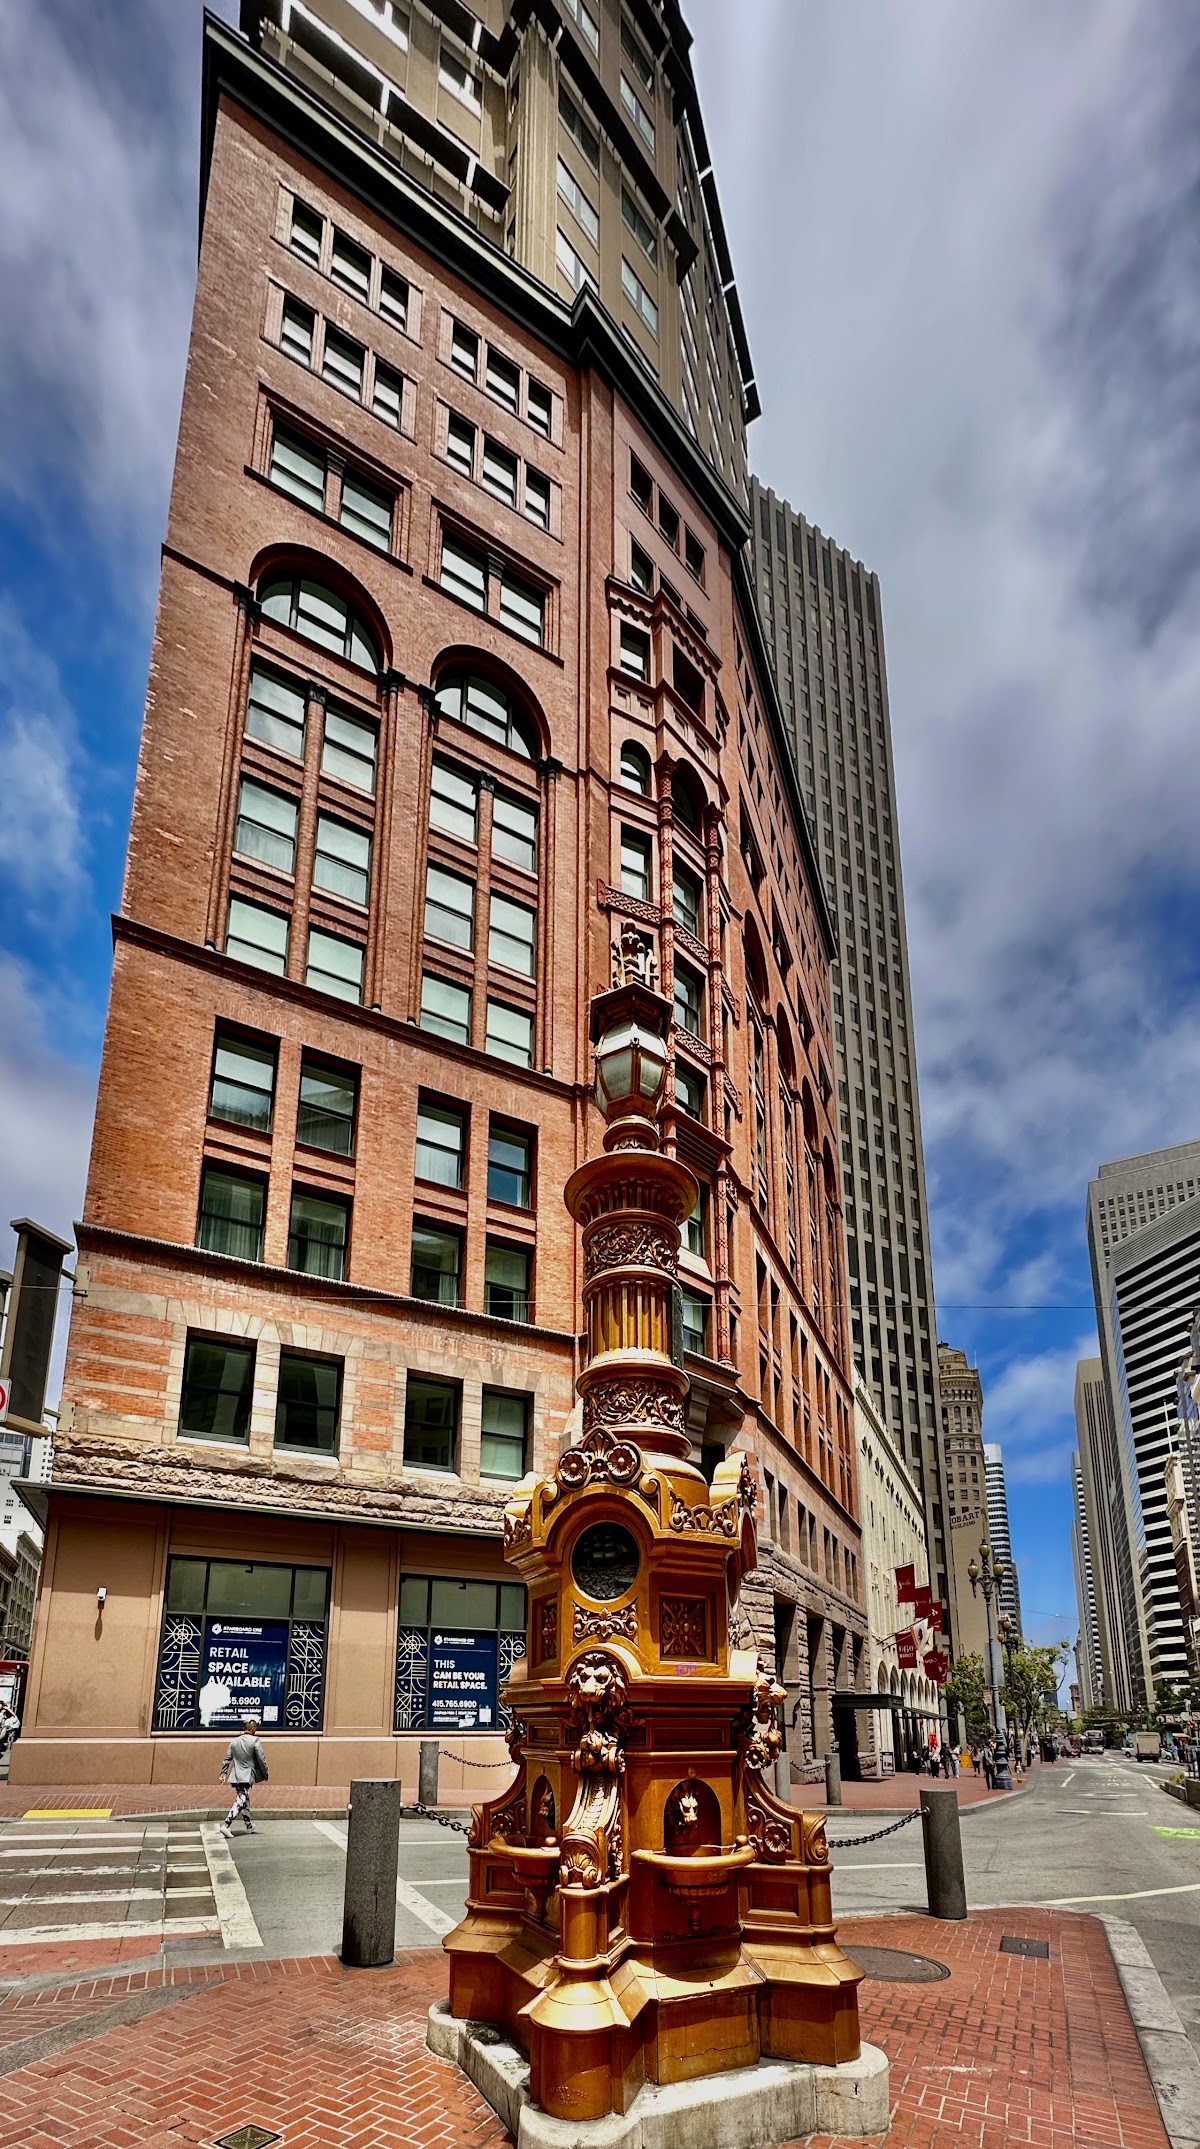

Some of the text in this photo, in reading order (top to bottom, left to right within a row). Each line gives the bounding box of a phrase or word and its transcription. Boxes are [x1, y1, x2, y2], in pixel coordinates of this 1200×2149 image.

[950, 1511, 979, 1524] OBART
[209, 1646, 249, 1659] RETAIL
[207, 1661, 249, 1674] SPACE
[434, 1659, 455, 1669] THIS
[207, 1675, 271, 1688] AVAILABLE
[433, 1671, 485, 1681] CAN BE YOUR
[433, 1680, 488, 1690] RETAIL SPACE.
[432, 1699, 477, 1708] 415.765.6900
